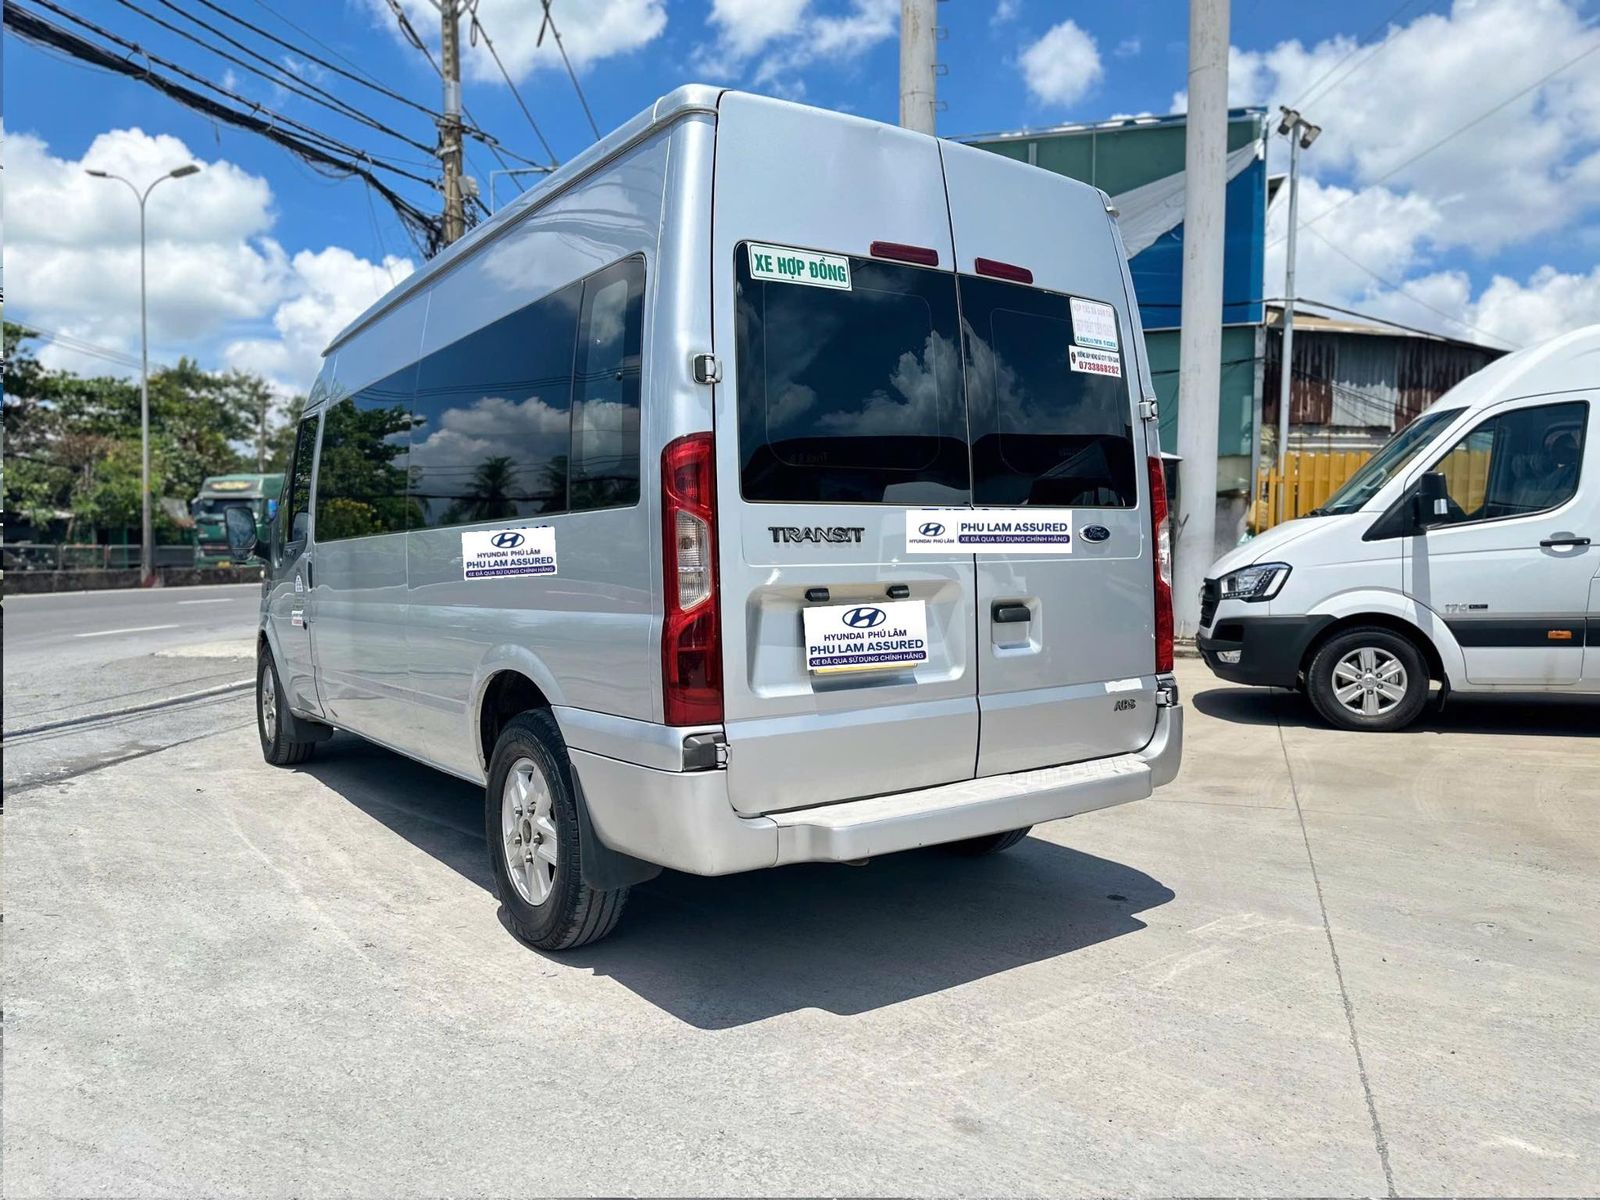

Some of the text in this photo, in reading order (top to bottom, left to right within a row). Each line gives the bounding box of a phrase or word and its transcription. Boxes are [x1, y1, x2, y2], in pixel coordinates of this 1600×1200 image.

[754, 254, 847, 283] XE HỢP ĐỒNG
[768, 526, 865, 543] TRANSIT
[1113, 699, 1136, 711] ABS
